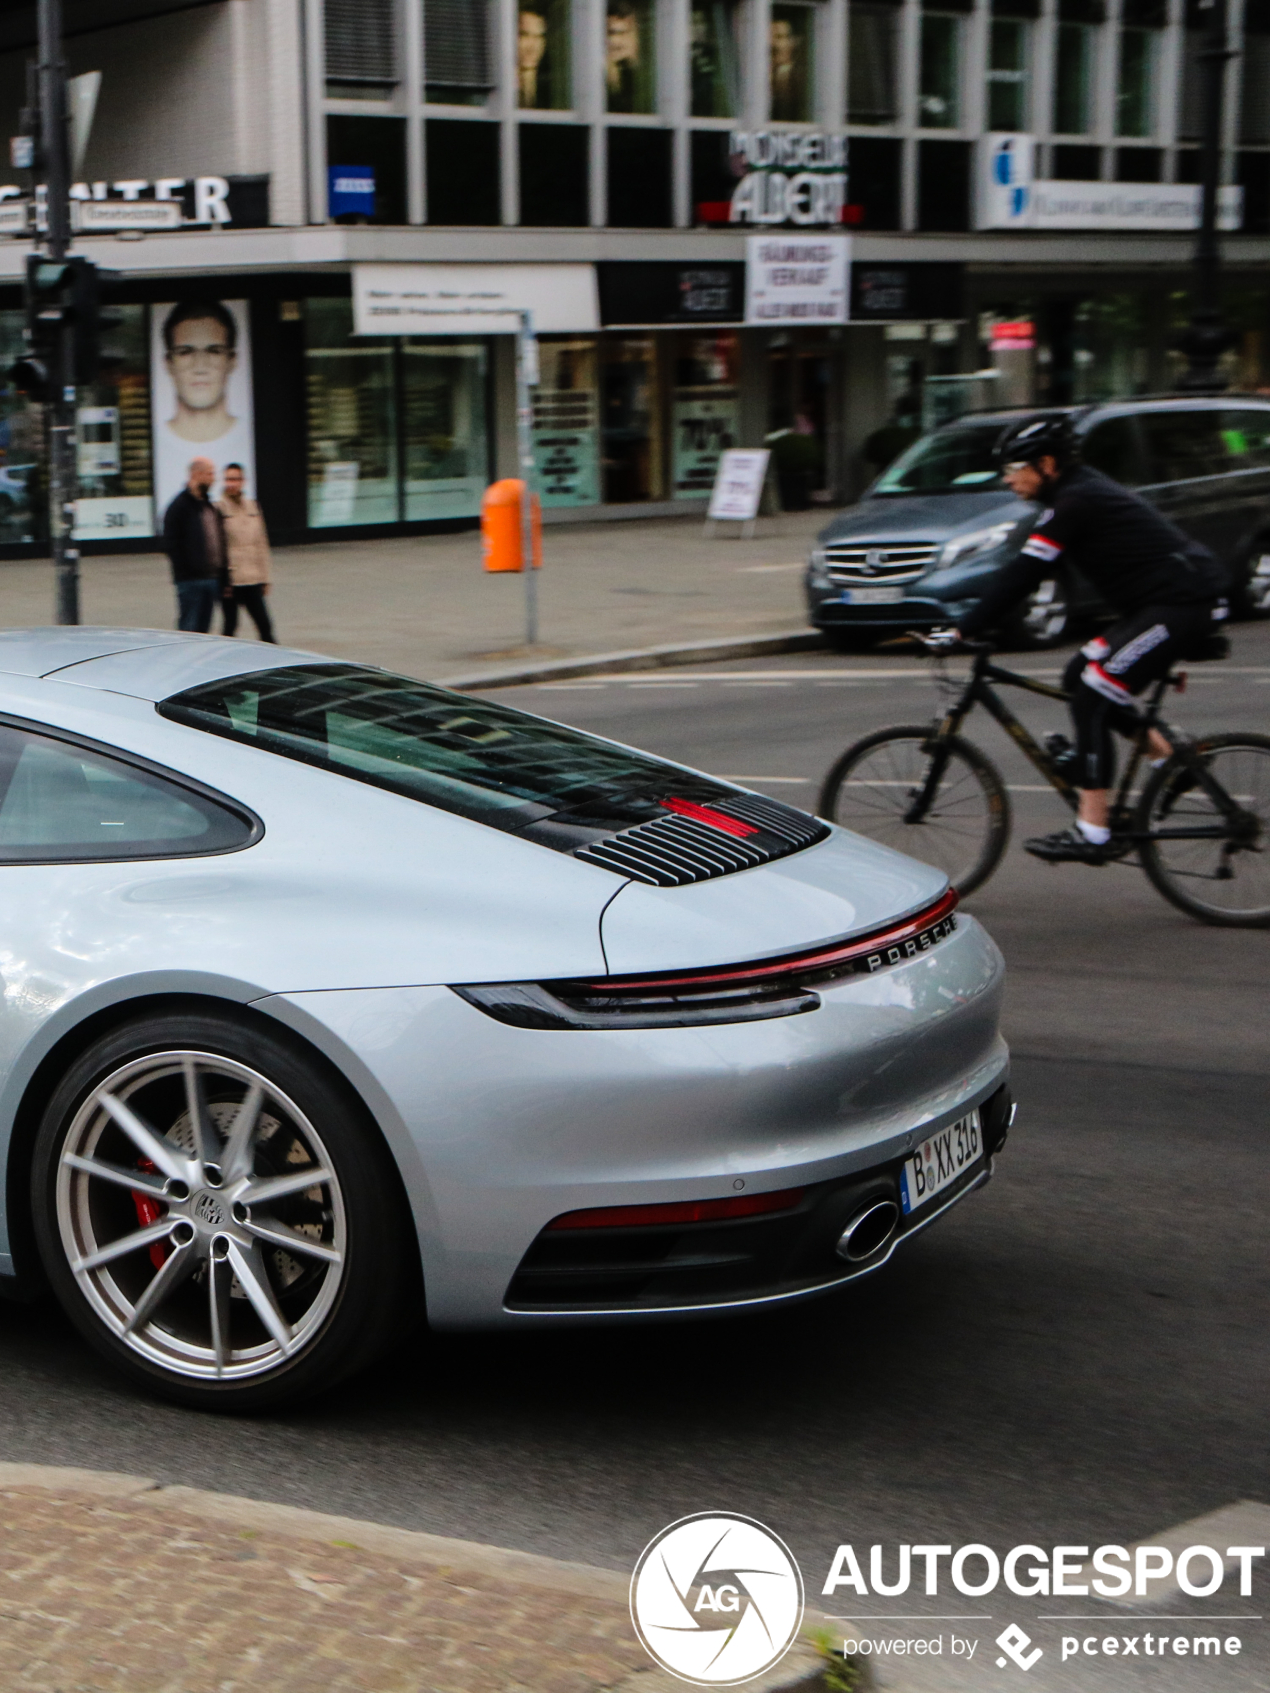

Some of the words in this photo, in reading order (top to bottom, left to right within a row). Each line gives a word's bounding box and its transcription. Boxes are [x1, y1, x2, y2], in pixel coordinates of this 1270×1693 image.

[867, 912, 959, 973] PORSCHE
[913, 1151, 926, 1198] B
[933, 1130, 956, 1185] XX
[954, 1113, 979, 1168] 316
